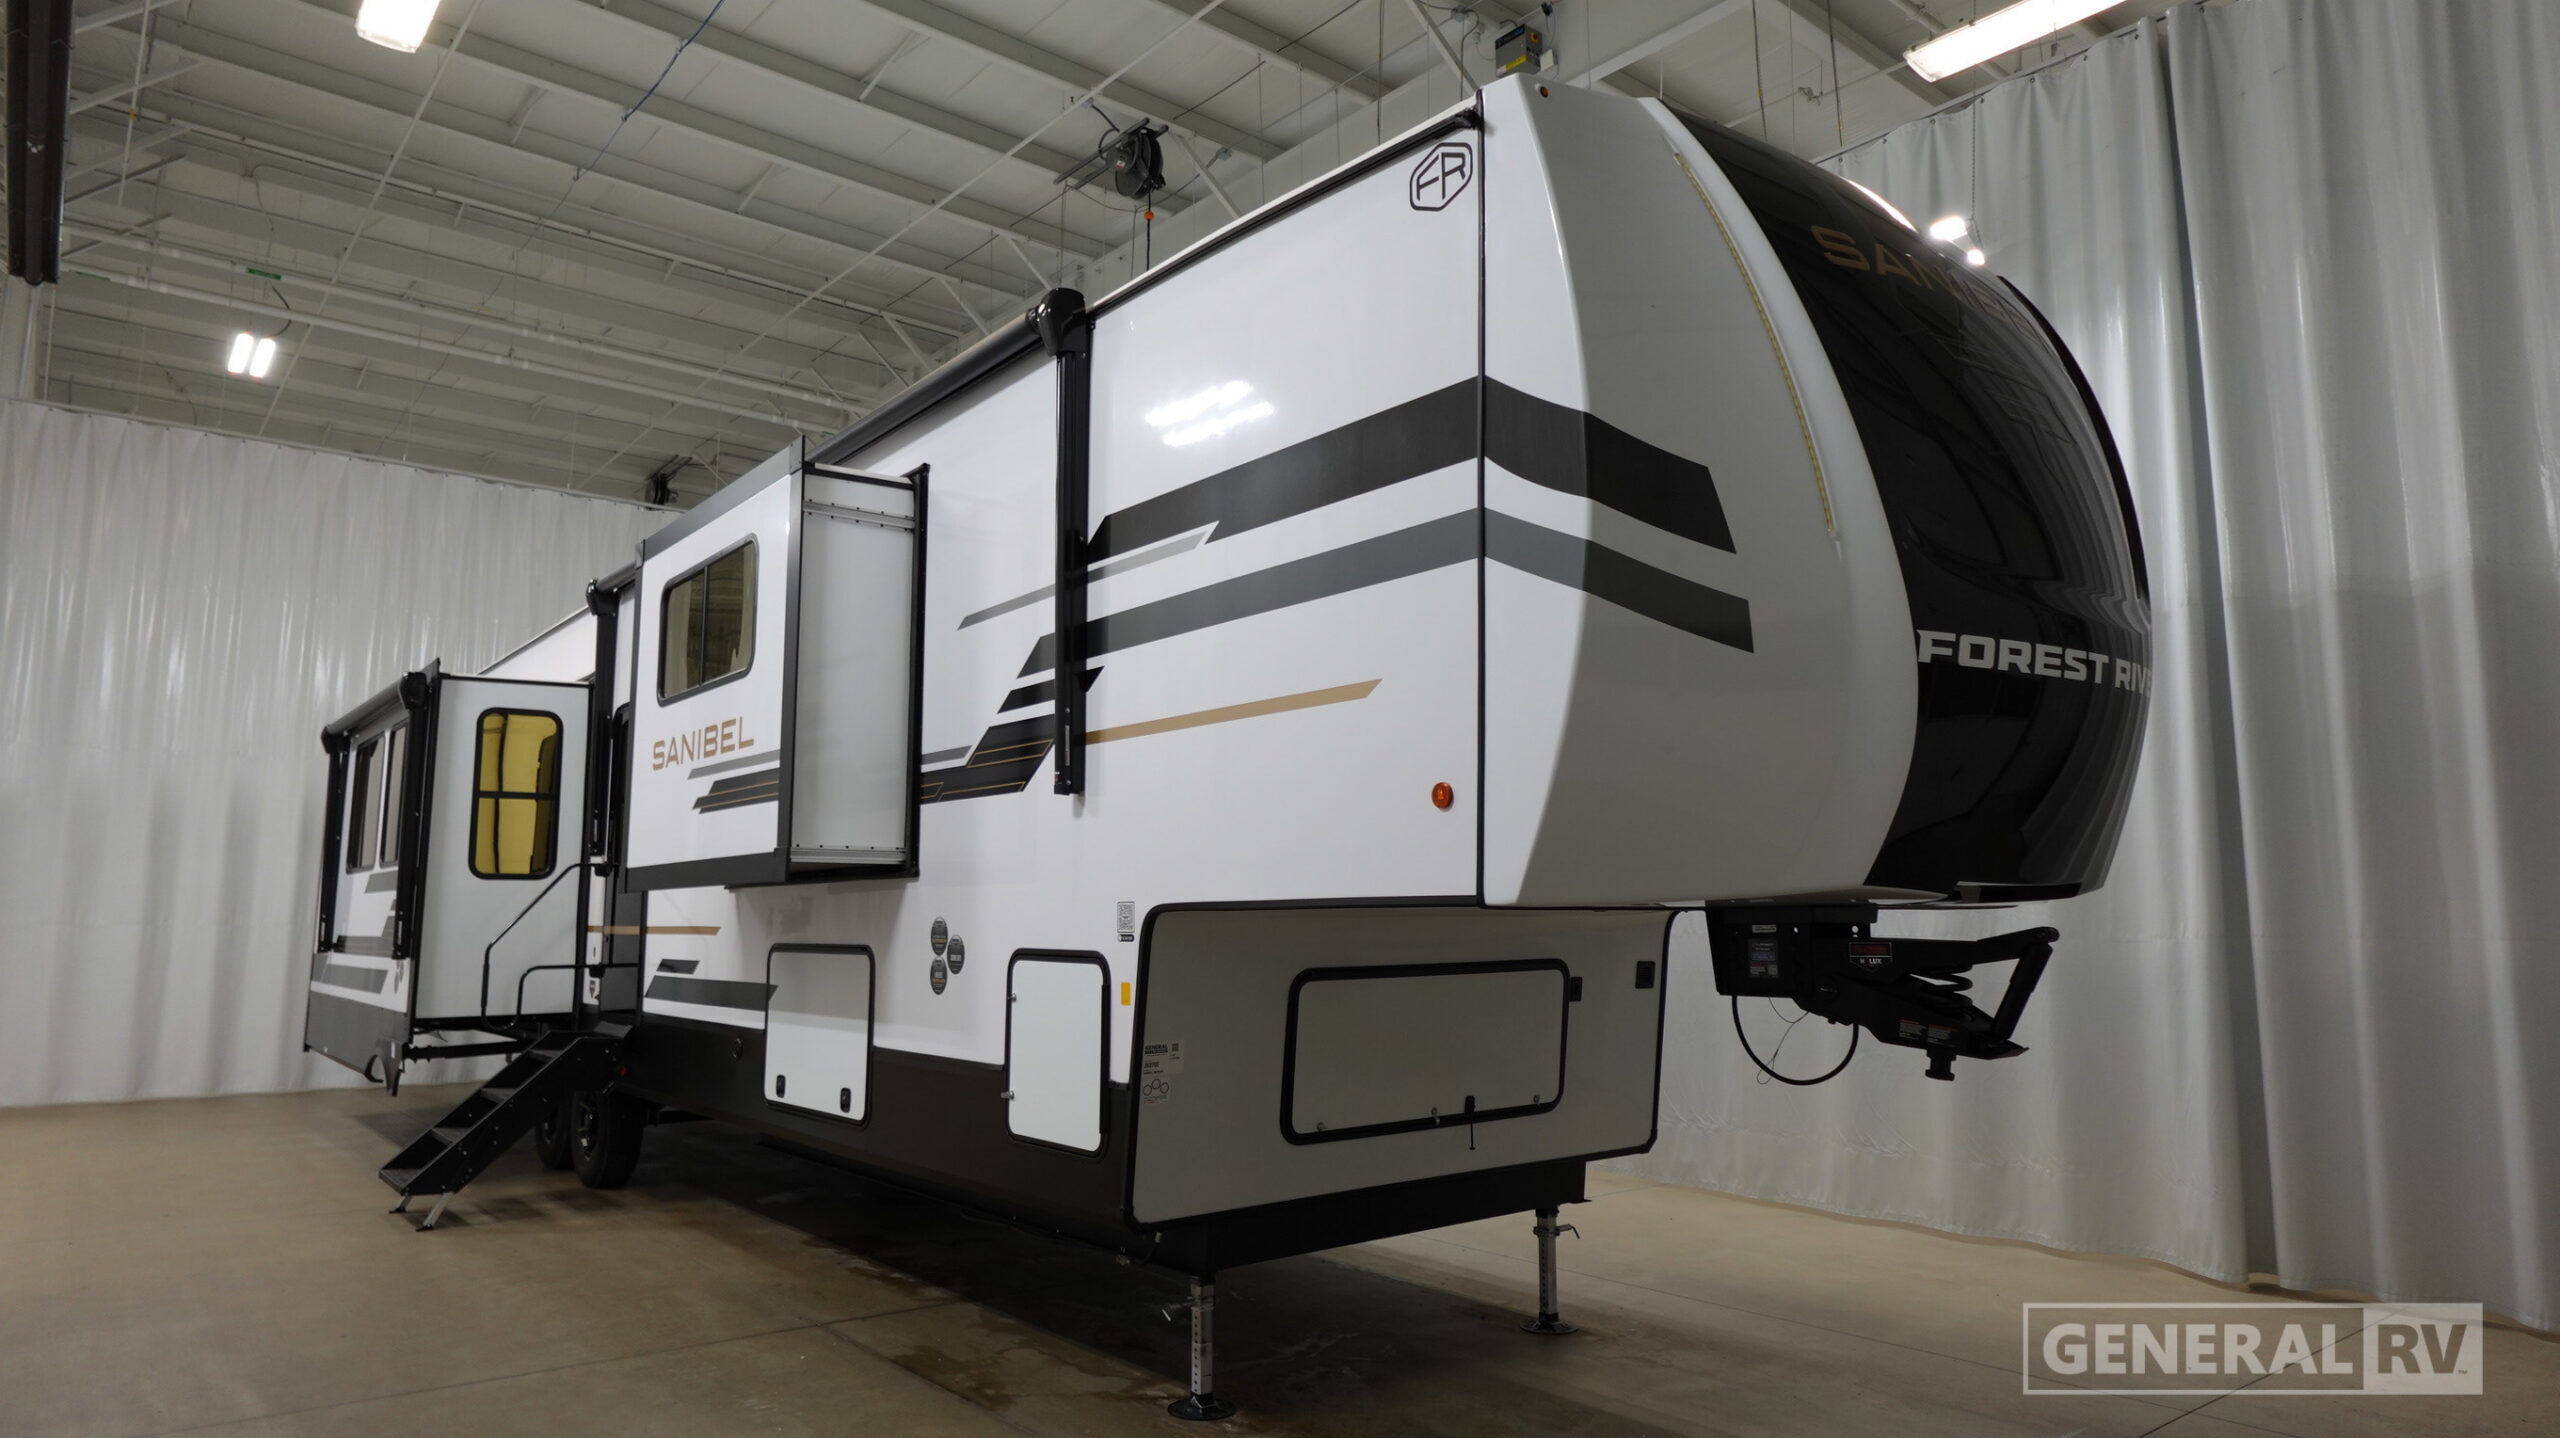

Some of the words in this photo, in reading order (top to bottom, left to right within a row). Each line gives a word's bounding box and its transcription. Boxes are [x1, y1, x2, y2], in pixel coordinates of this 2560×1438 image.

[1416, 152, 1466, 201] FR
[1916, 629, 2110, 685] FOREST
[652, 716, 755, 771] SANIBEL
